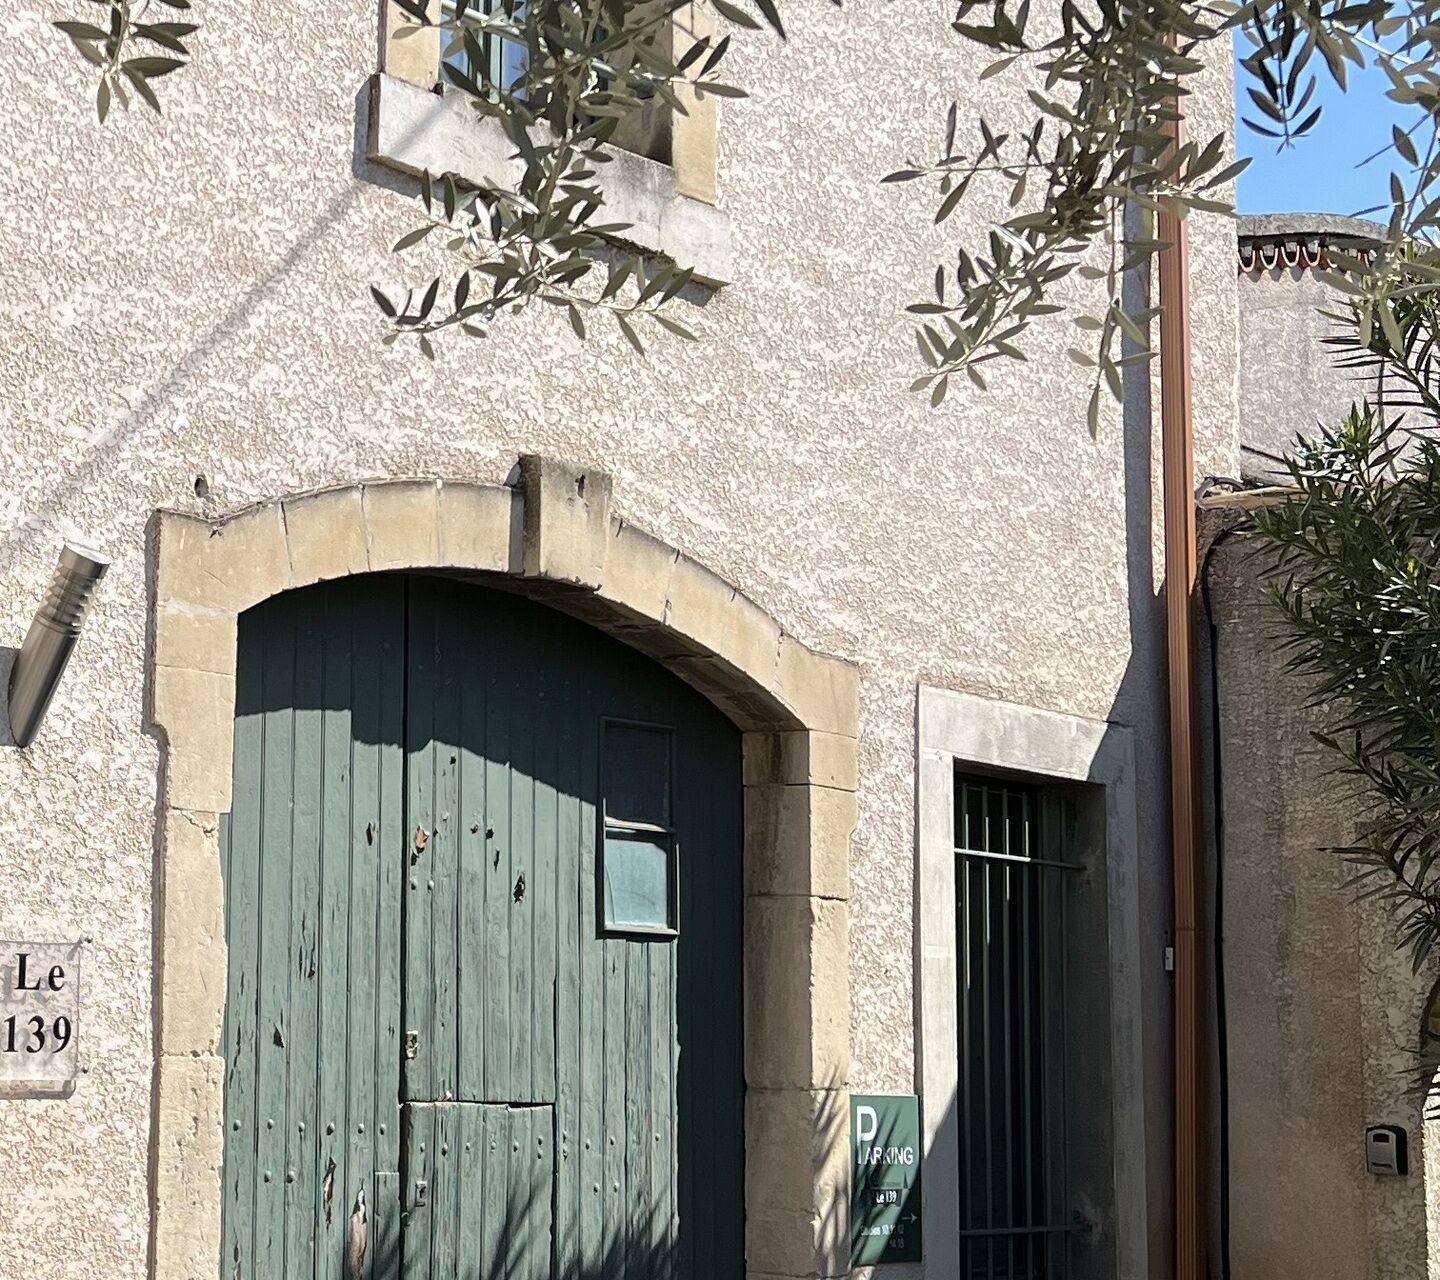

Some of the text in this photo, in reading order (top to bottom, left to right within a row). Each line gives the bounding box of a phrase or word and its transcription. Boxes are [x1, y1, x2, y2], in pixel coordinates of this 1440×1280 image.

[13, 952, 66, 992] Le
[2, 1014, 72, 1054] 139
[856, 1105, 914, 1166] PARKING
[876, 1190, 897, 1204] Le 139
